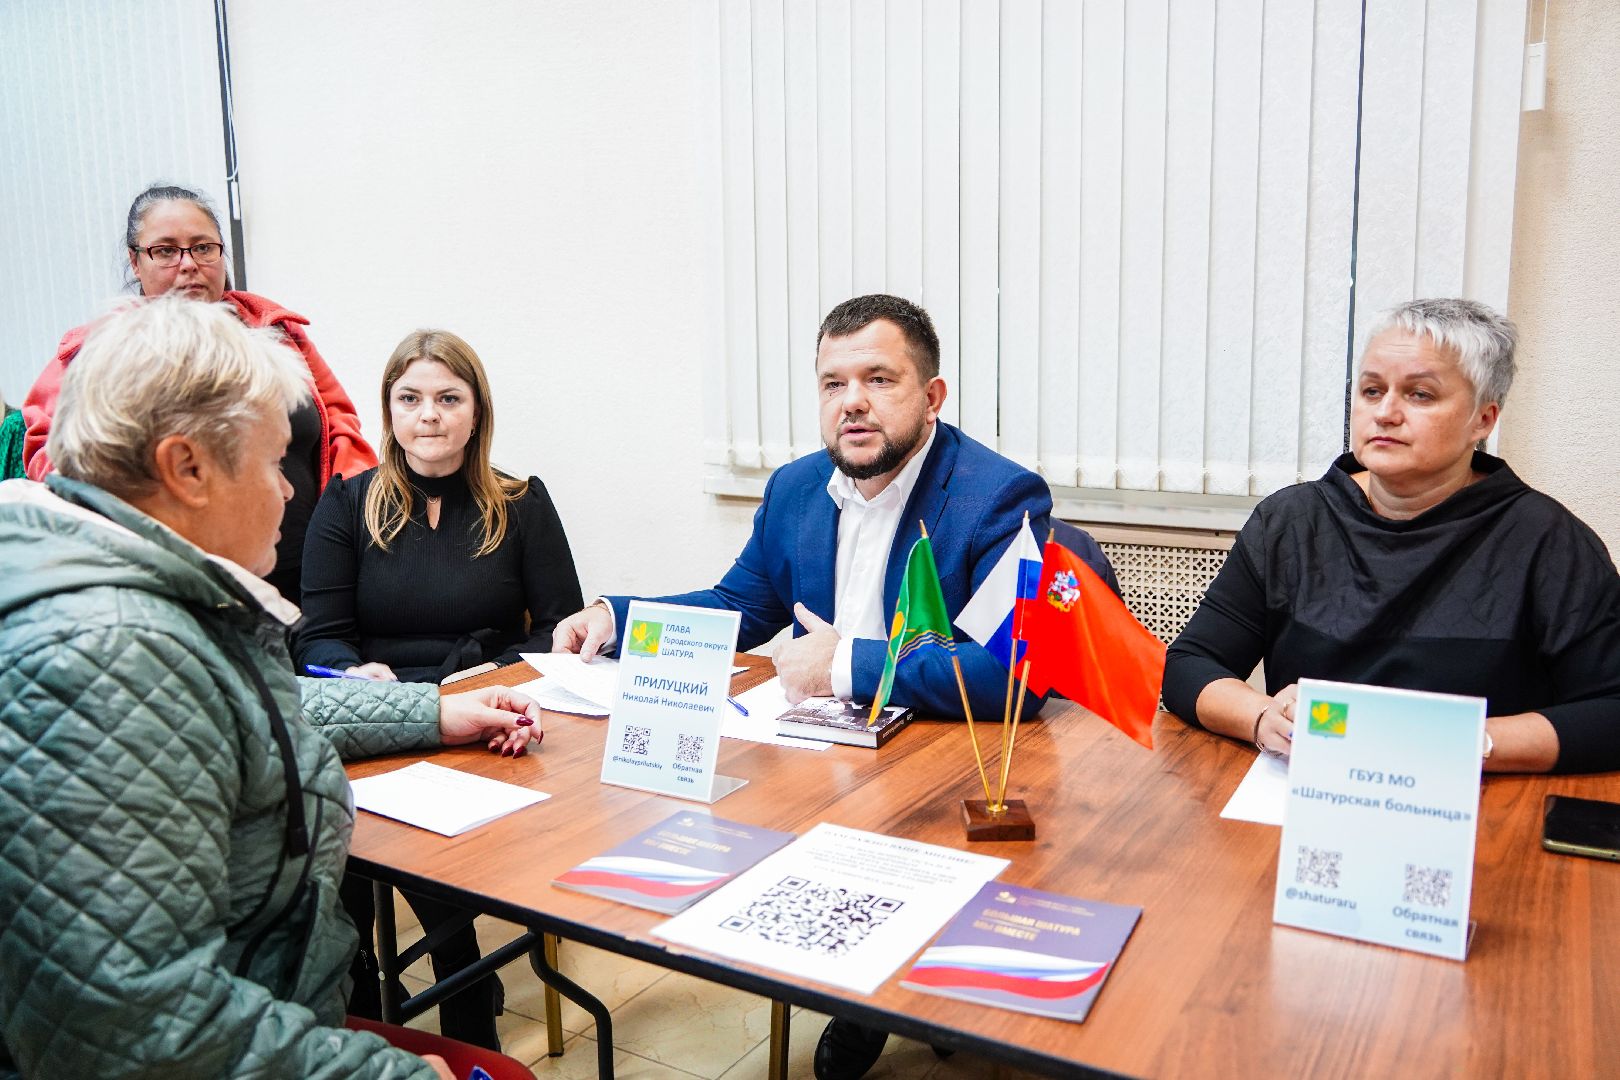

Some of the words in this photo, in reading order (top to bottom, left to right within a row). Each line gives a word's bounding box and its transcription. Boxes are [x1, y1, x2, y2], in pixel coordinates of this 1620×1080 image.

[665, 624, 691, 634] ГЛАВА
[661, 648, 694, 659] ШАТУРА
[664, 636, 703, 648] Городского
[704, 642, 728, 651] округа
[634, 675, 709, 696] ПРИЛУЦКИЙ
[622, 692, 659, 705] Николай
[661, 698, 715, 713] Николаевич
[672, 763, 703, 774] Обратная
[1349, 768, 1384, 783] ГБУЗ
[1388, 773, 1416, 788] МО
[1292, 786, 1380, 809] «Шатурская
[1385, 798, 1472, 822] больница»
[1285, 887, 1357, 910] @shaturaru
[1392, 905, 1459, 928] Обратная
[1405, 928, 1443, 944] связь
